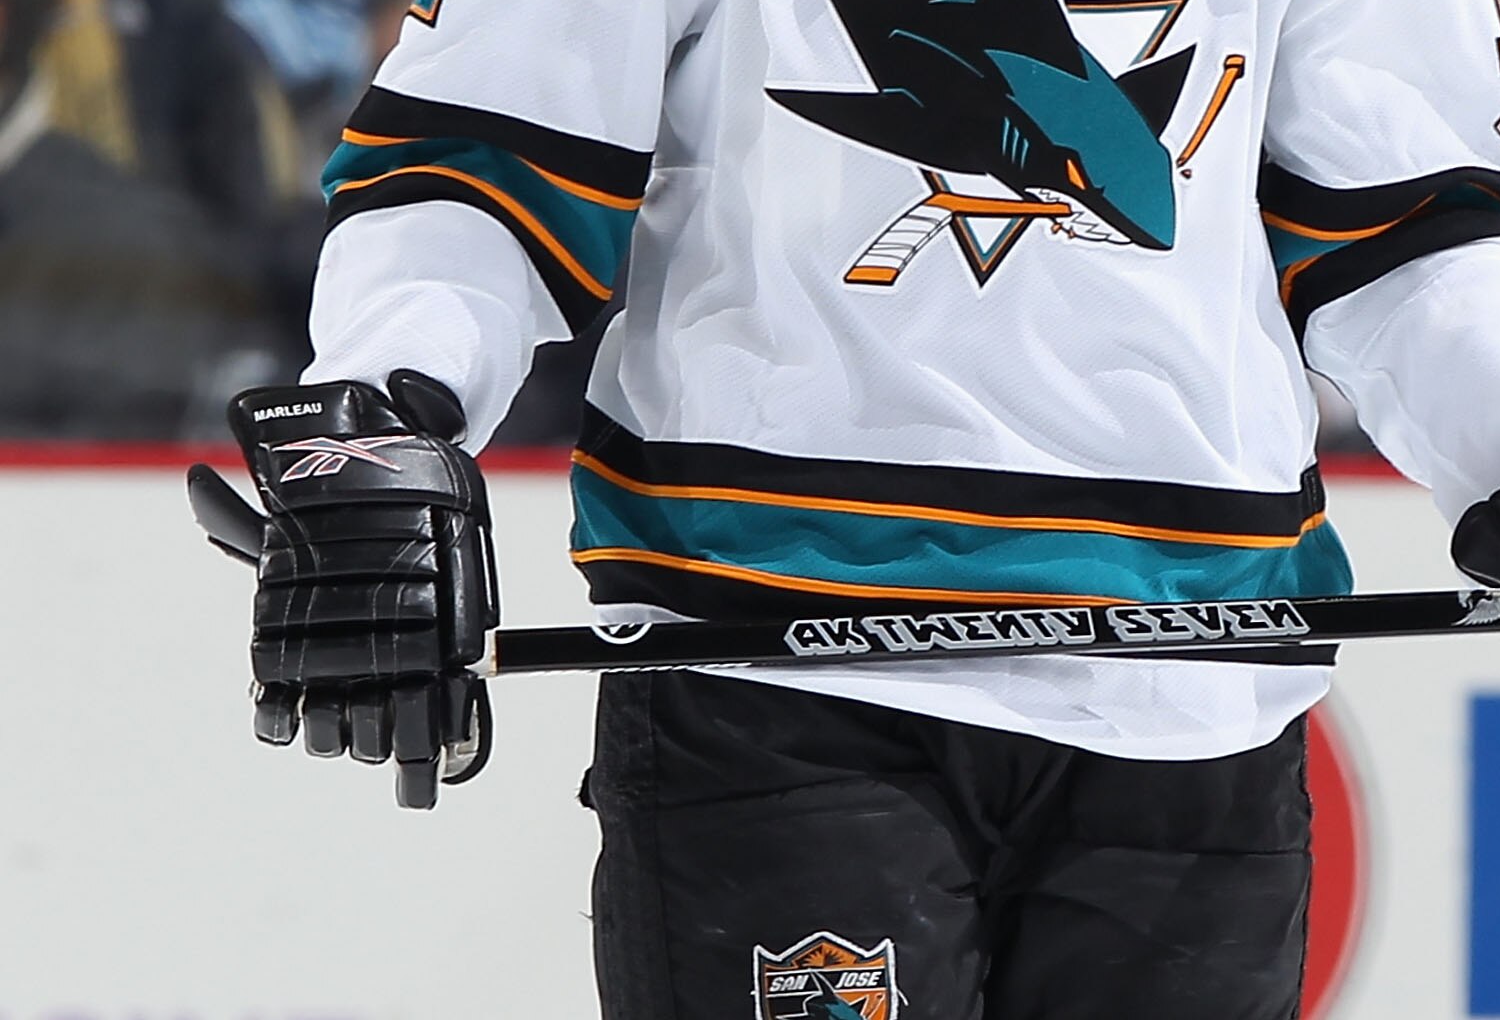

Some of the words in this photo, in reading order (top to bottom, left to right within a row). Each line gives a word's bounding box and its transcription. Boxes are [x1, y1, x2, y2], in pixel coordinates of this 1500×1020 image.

[254, 402, 323, 422] MARLEAU
[784, 617, 872, 656] AK
[860, 607, 1096, 653] TWENTY
[1105, 599, 1311, 643] SEVEN
[769, 974, 809, 992] SAN
[835, 971, 882, 989] JOSE
